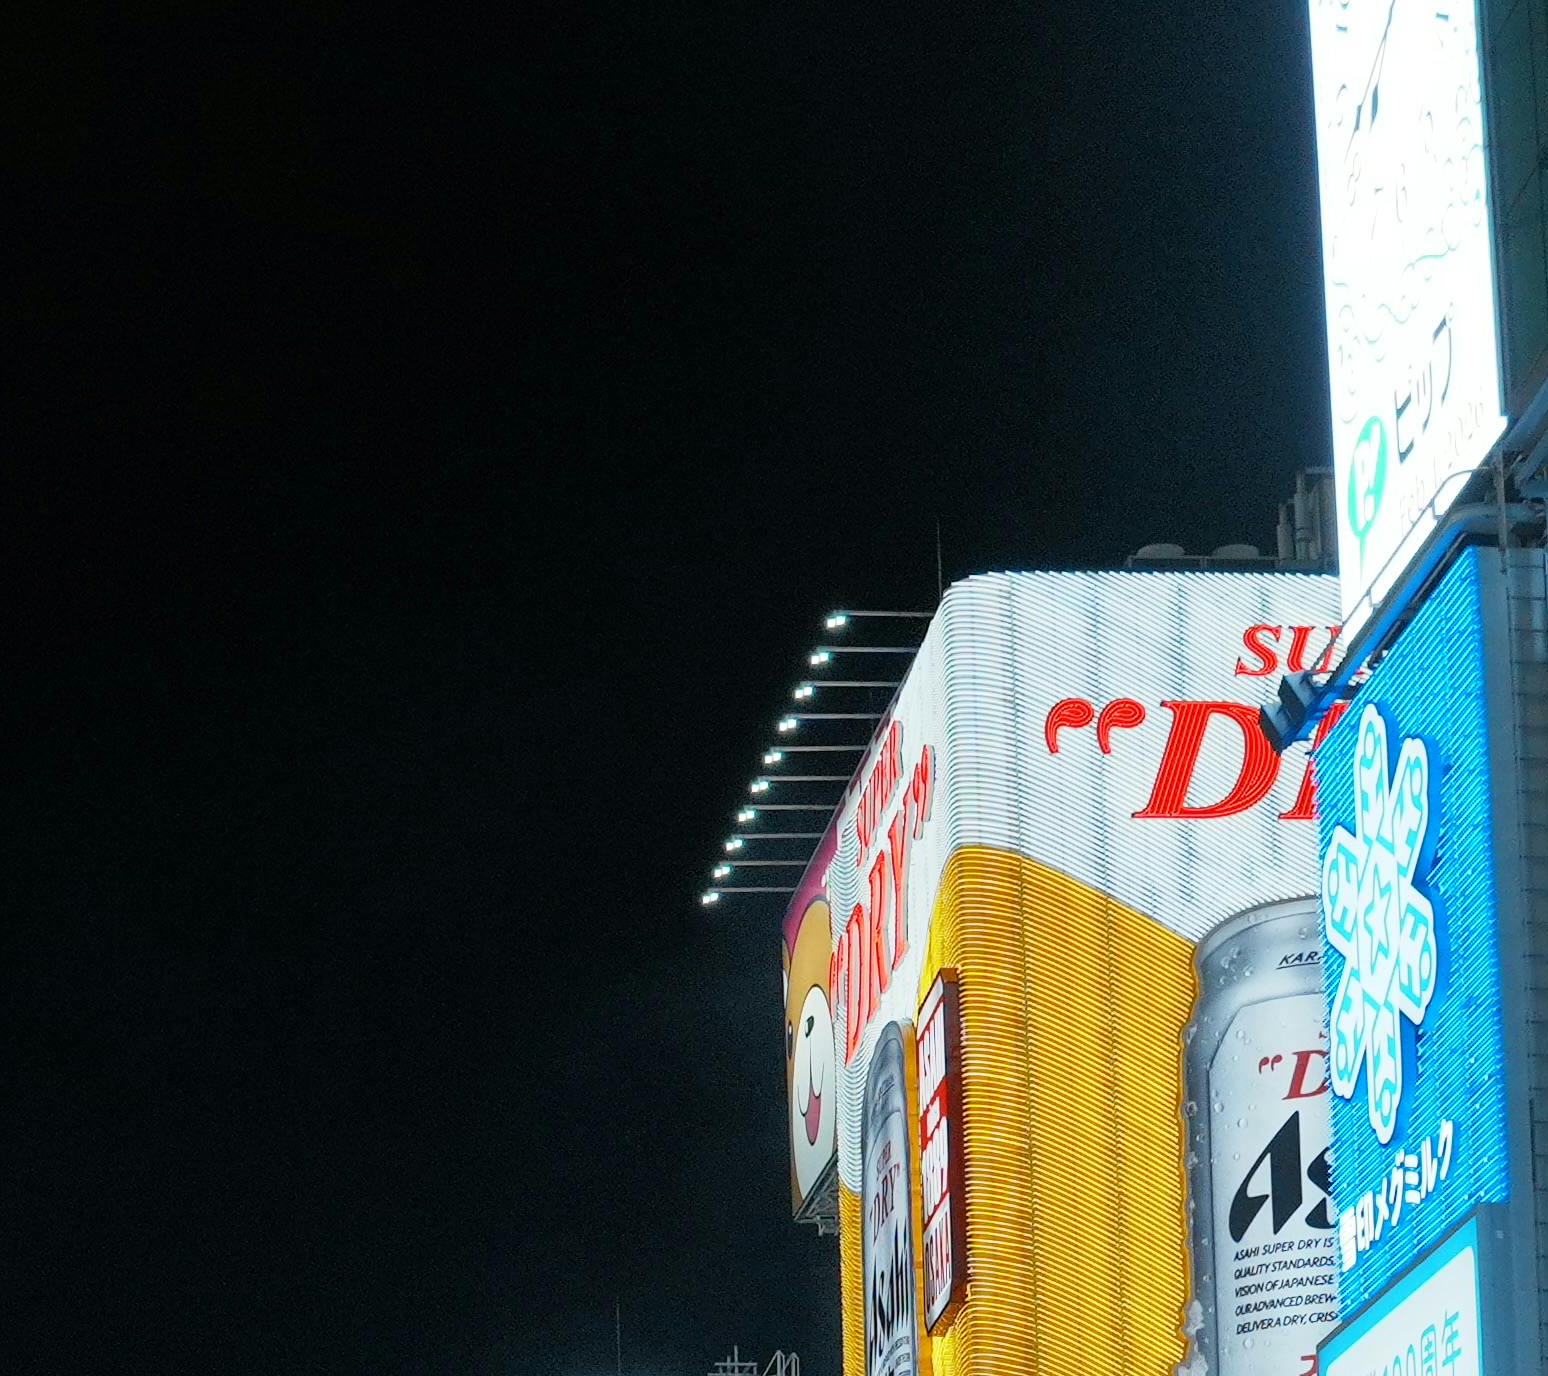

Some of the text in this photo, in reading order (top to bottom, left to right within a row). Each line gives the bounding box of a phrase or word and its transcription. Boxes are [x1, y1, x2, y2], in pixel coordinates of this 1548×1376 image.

[1234, 623, 1351, 677] SU
[1337, 1118, 1454, 1273] 雪印メグミルク
[924, 1210, 952, 1310] OSAKA
[1233, 1236, 1334, 1262] ASAHI SUPER DRY IS
[1234, 1262, 1271, 1280] QUALITY
[1235, 1274, 1335, 1299] VISION OF JAPANESE
[1235, 1300, 1254, 1317] OUR
[1253, 1296, 1304, 1313] ADVANCED
[1236, 1318, 1272, 1335] DELIVER
[1272, 1316, 1282, 1329] A
